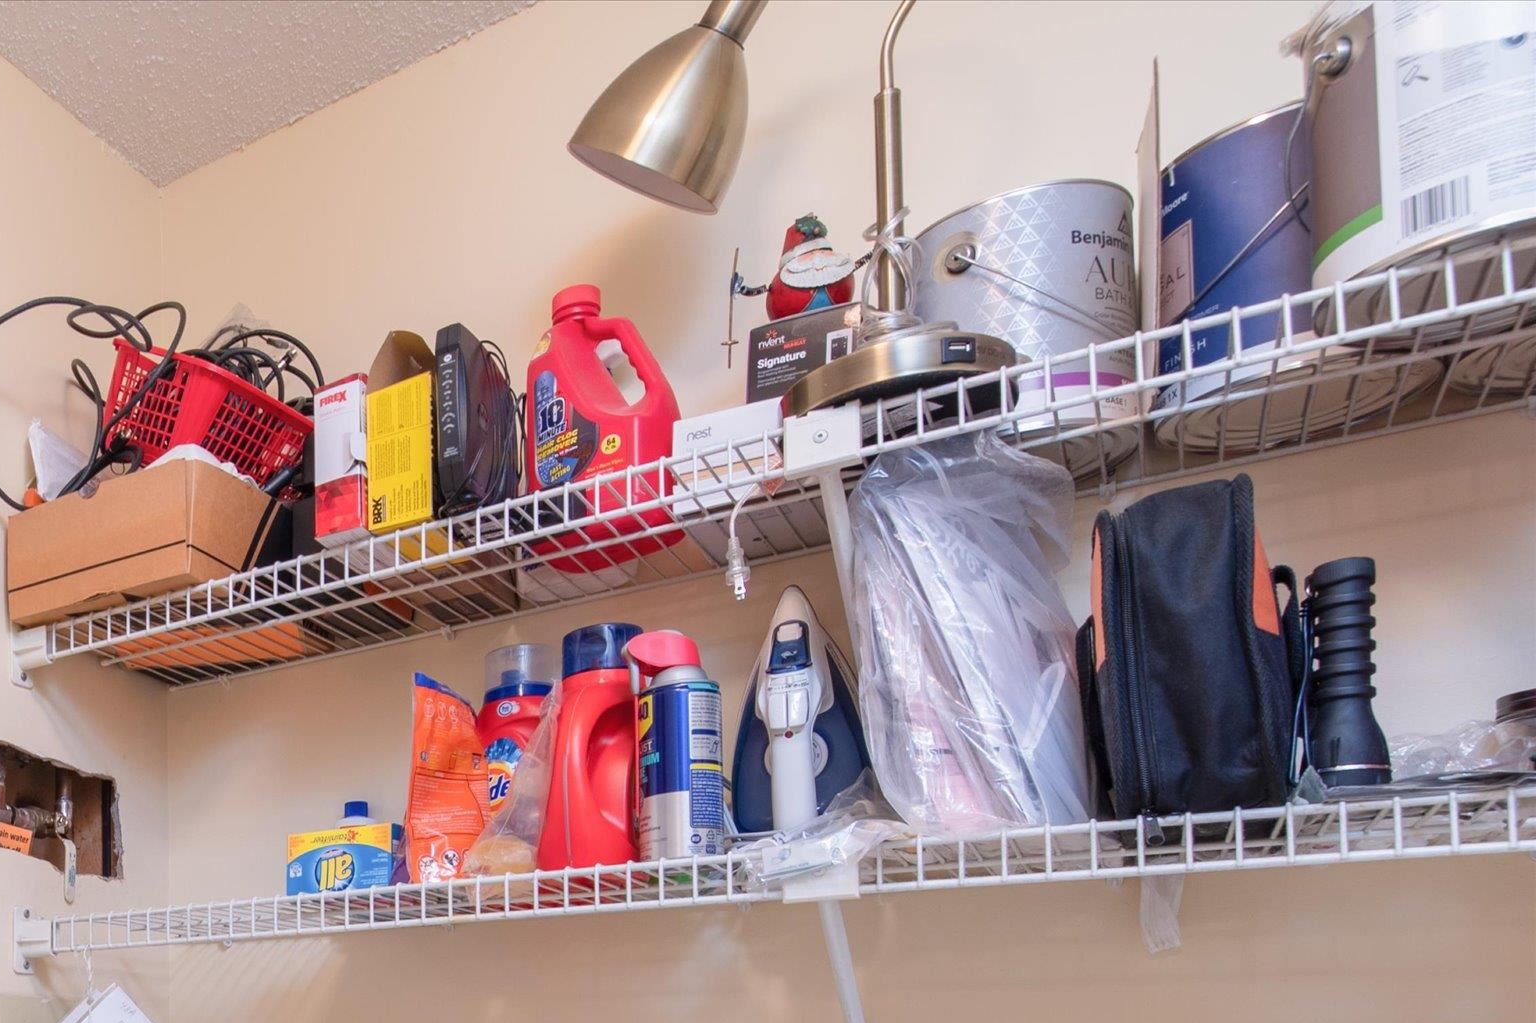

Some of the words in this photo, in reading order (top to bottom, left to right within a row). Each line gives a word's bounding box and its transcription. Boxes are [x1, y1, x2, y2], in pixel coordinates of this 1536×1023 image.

[757, 351, 807, 369] Signature
[1164, 338, 1207, 372] FINSH
[320, 390, 346, 407] FIREX
[557, 428, 578, 443] CLOG
[606, 436, 616, 446] 64
[686, 426, 712, 442] nest
[372, 496, 382, 525] BRK
[489, 775, 511, 801] de
[10, 833, 29, 844] water
[320, 853, 353, 892] all
